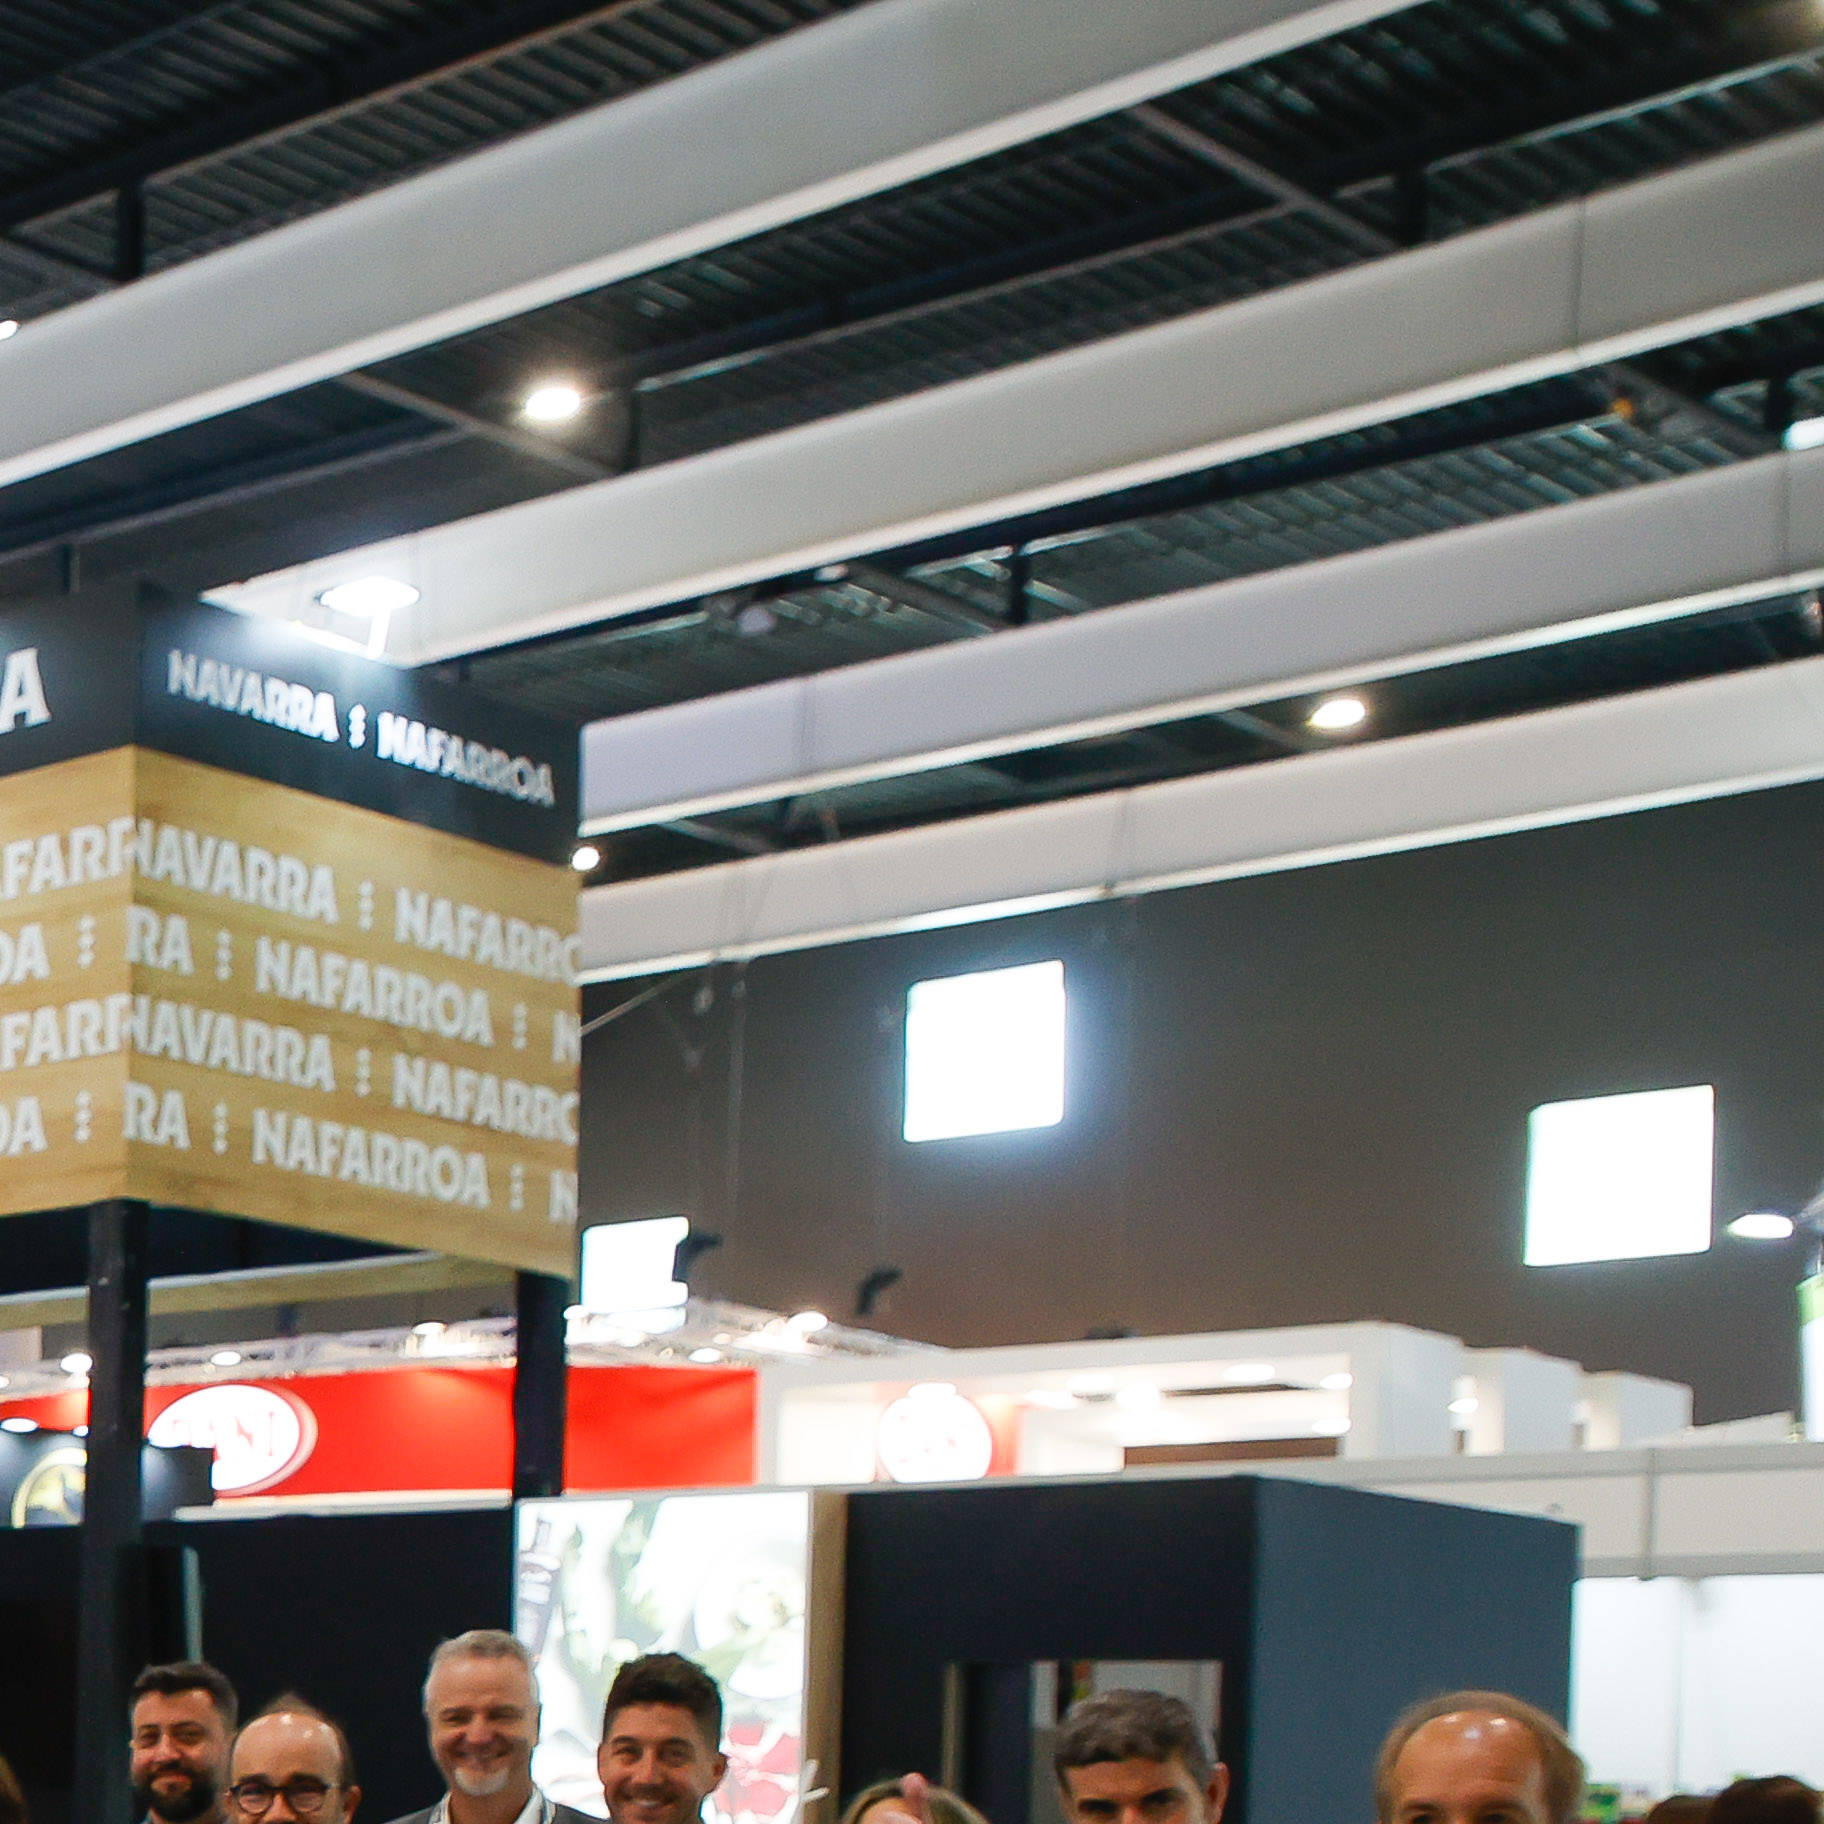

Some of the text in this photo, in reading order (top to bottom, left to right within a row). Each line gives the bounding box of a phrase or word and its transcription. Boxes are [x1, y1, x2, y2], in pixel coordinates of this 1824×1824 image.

[168, 649, 556, 807] NAVARRA NAFARROA
[125, 904, 195, 977] RA
[256, 935, 494, 1048] NAFARROA
[123, 1080, 192, 1151] RA
[253, 1106, 491, 1210] NAFARROA
